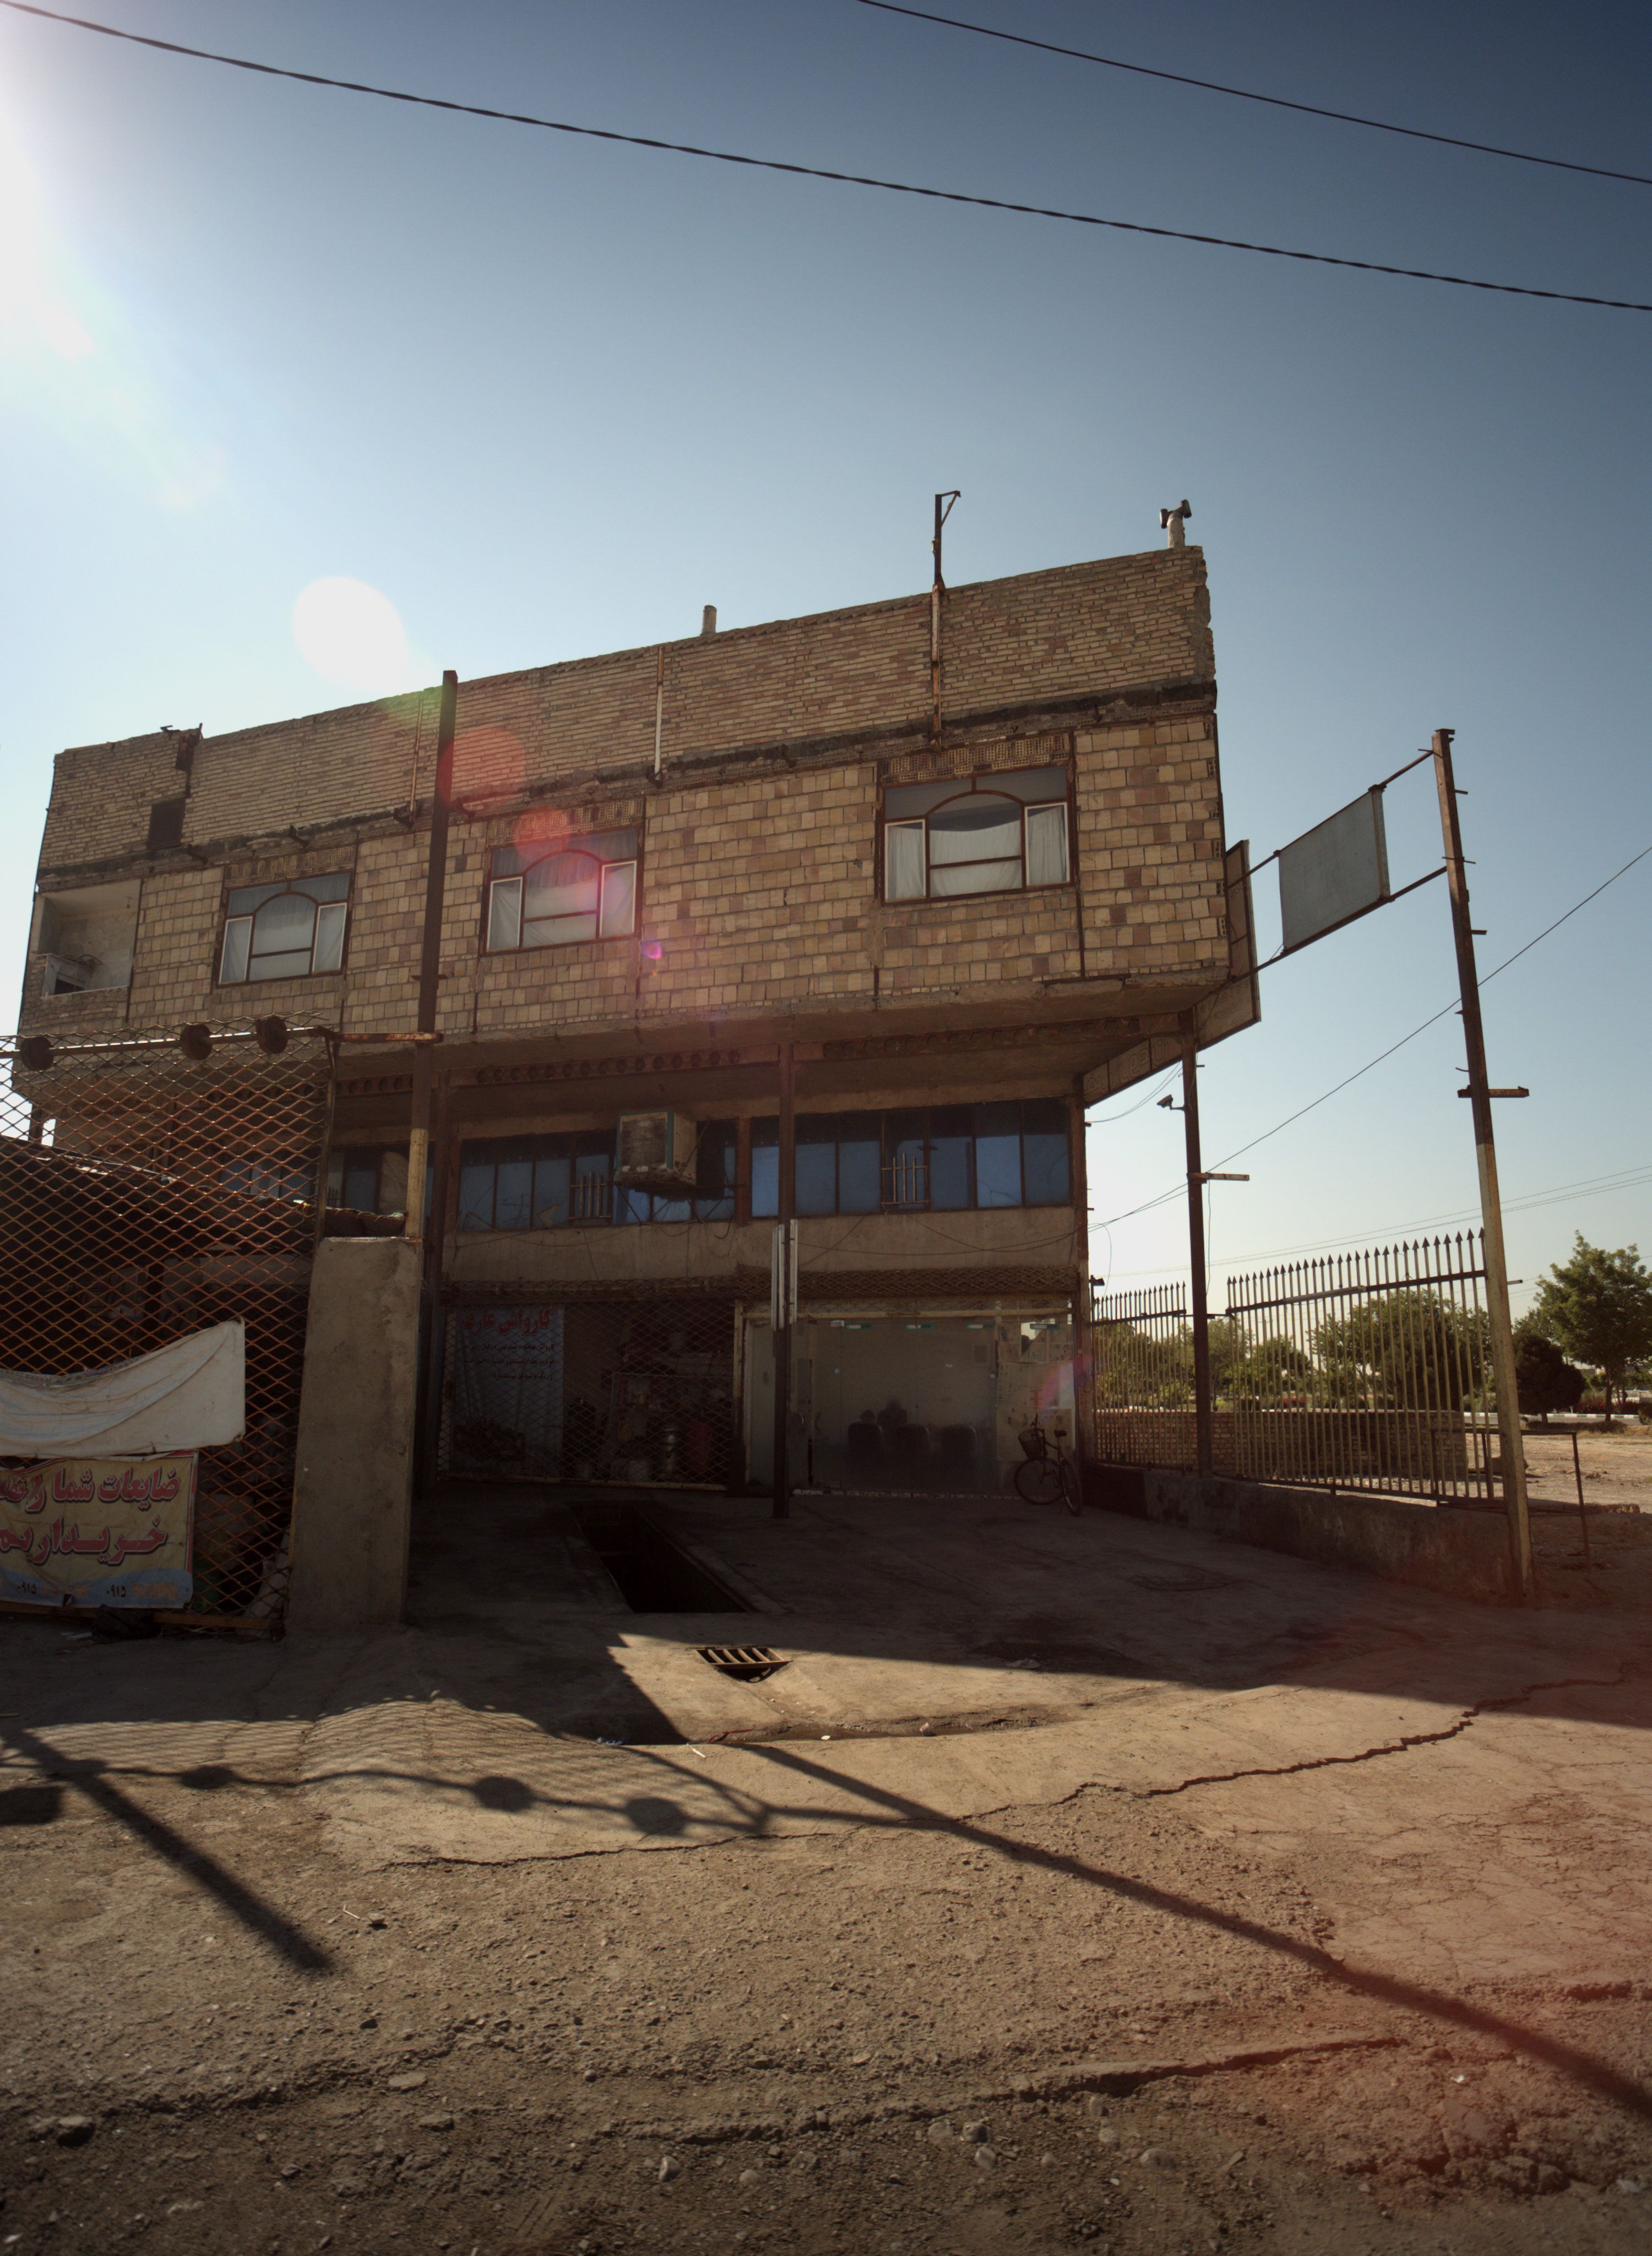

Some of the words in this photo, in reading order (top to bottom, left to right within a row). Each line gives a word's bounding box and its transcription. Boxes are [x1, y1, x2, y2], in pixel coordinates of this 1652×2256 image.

[25, 1474, 46, 1512] را
[52, 1466, 95, 1503] شما
[99, 1466, 182, 1511] ضایعات
